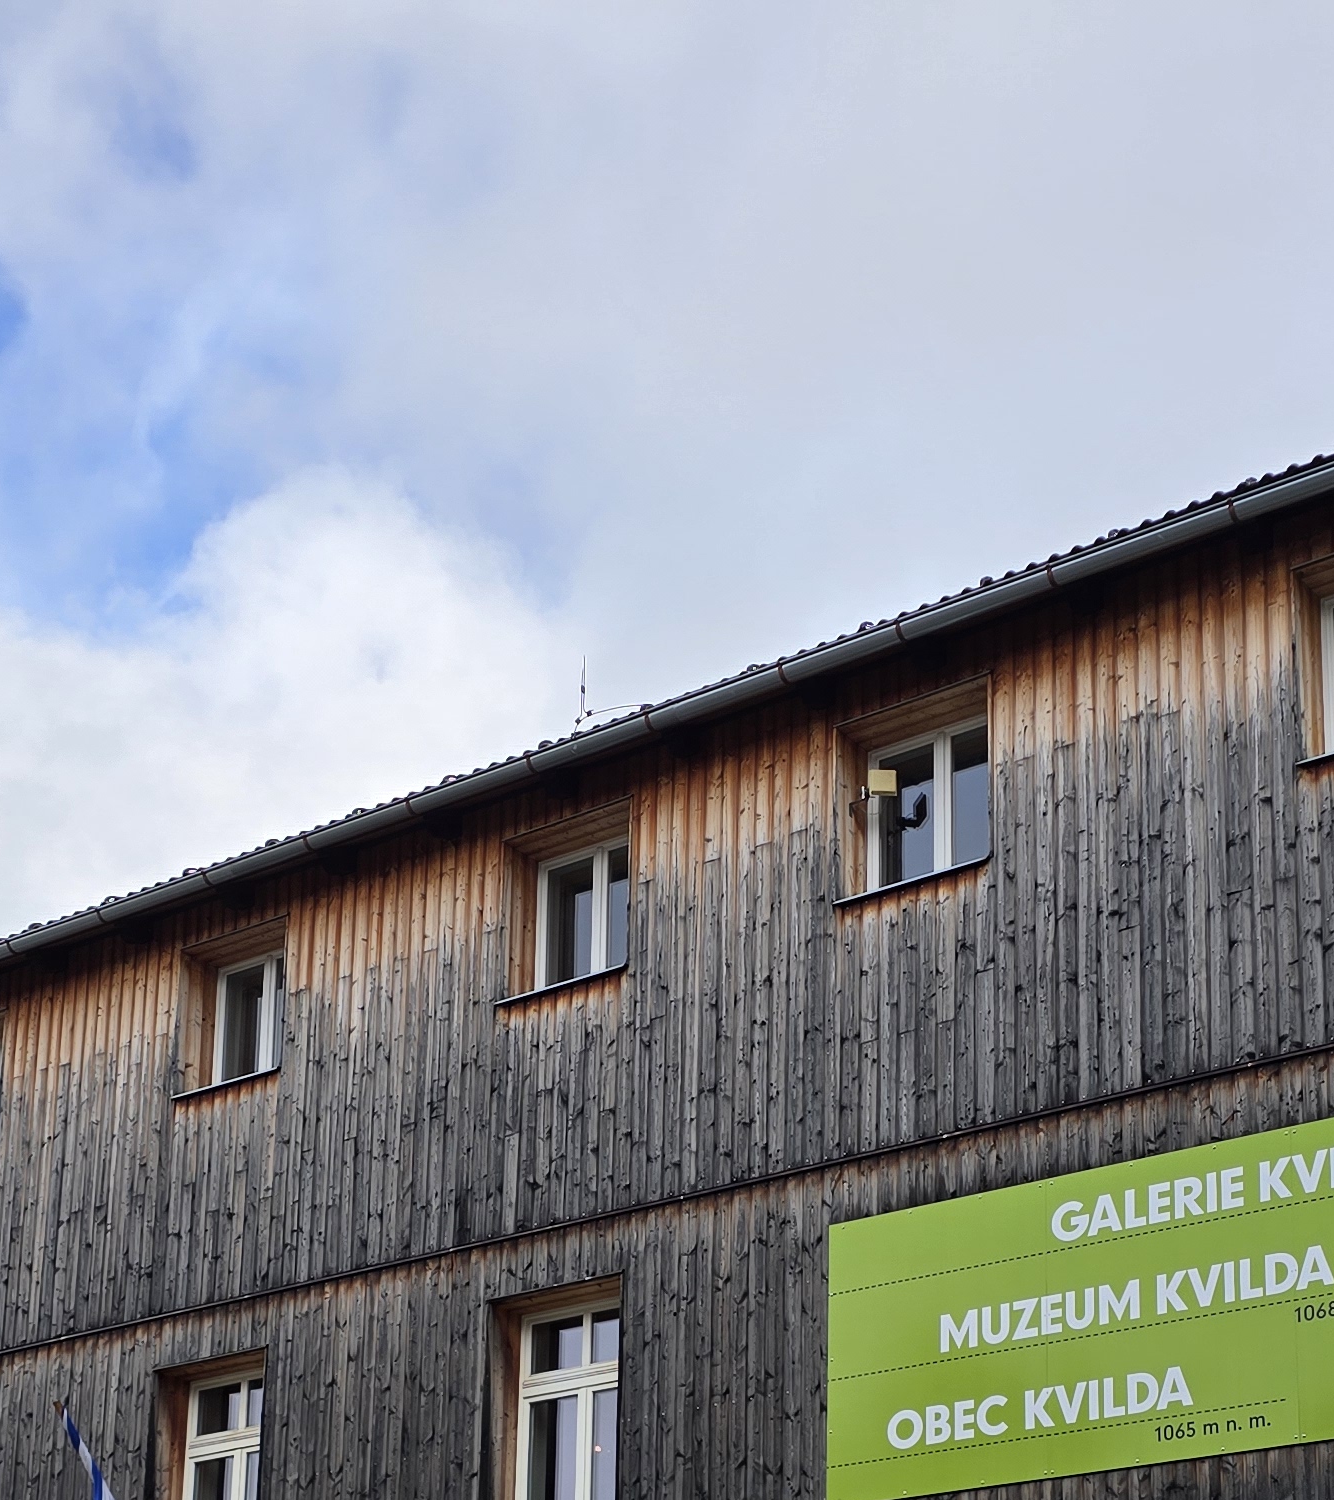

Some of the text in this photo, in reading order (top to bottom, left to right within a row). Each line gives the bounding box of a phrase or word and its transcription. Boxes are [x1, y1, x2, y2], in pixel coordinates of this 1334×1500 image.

[1051, 1166, 1244, 1242] GALERIE
[940, 1245, 1334, 1353] MUZEUM KVILDA
[887, 1365, 1193, 1450] OBEC KVILDA
[1154, 1413, 1272, 1442] 1065 m n. m.
